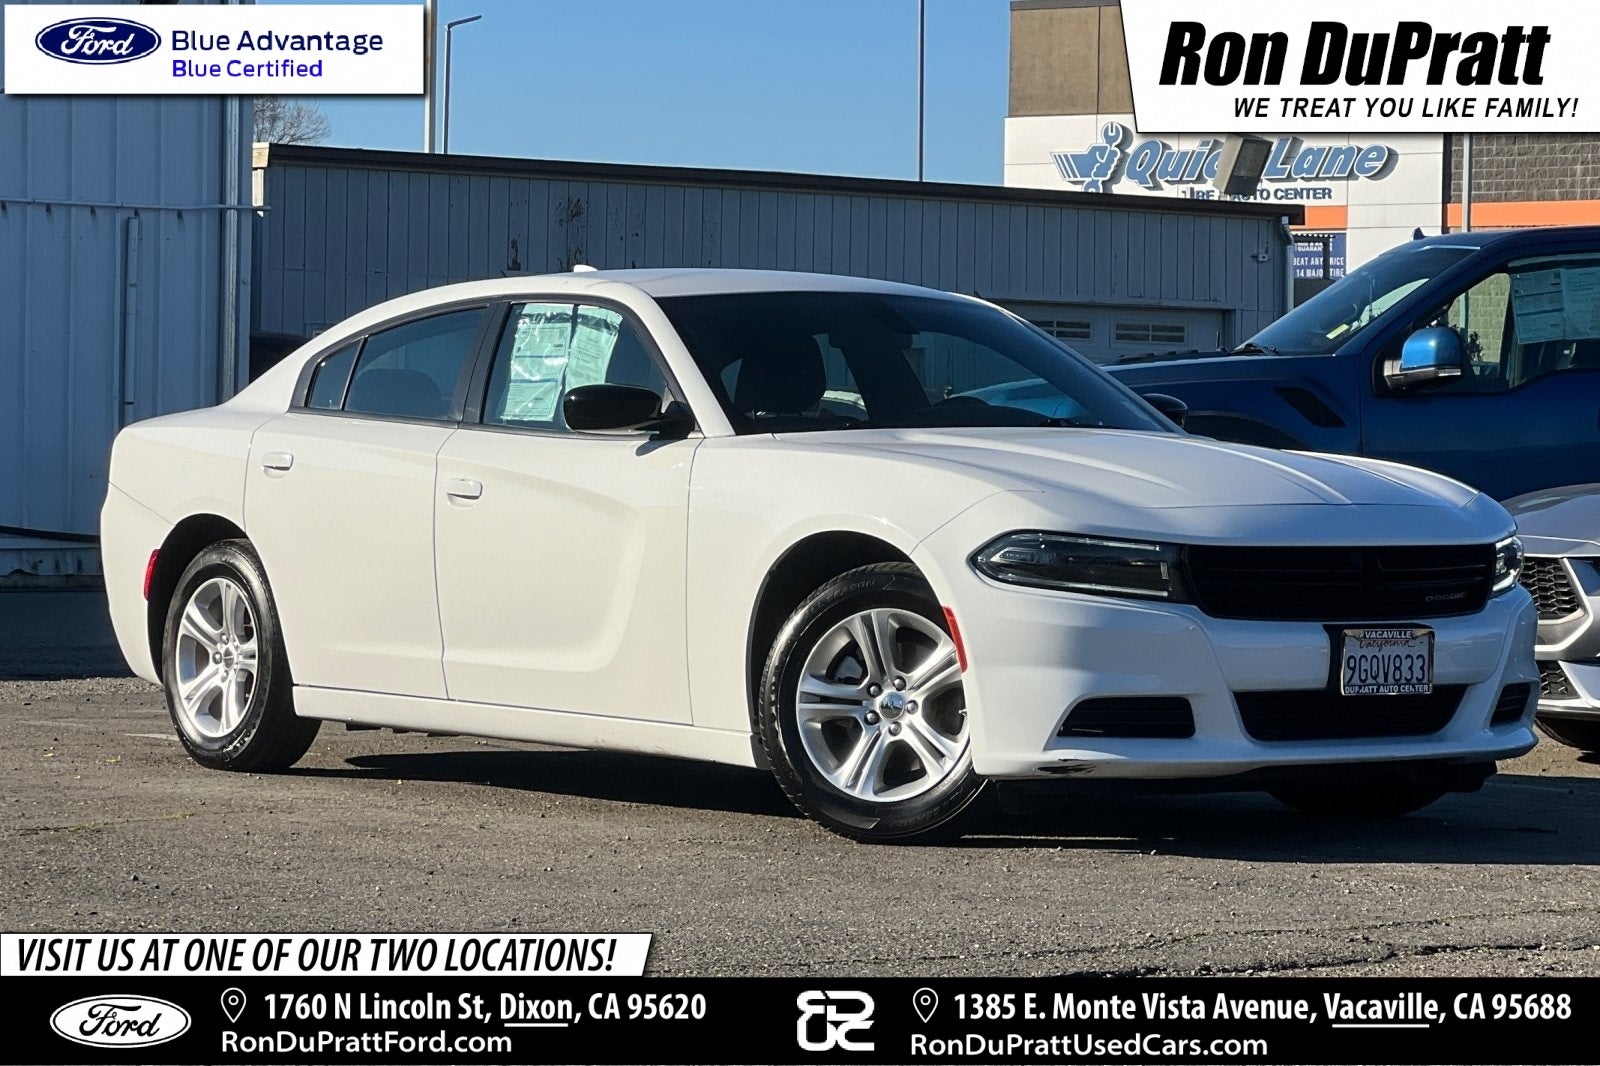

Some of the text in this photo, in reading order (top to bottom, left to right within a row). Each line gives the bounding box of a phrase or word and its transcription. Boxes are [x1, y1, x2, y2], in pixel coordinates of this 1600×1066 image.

[1125, 136, 1390, 188] Quic Lane
[1273, 187, 1332, 200] CENTER
[1329, 257, 1344, 266] RICE
[1306, 269, 1323, 278] MAJO
[1365, 630, 1412, 639] VACAVILLE
[1346, 653, 1426, 684] 9GQV833
